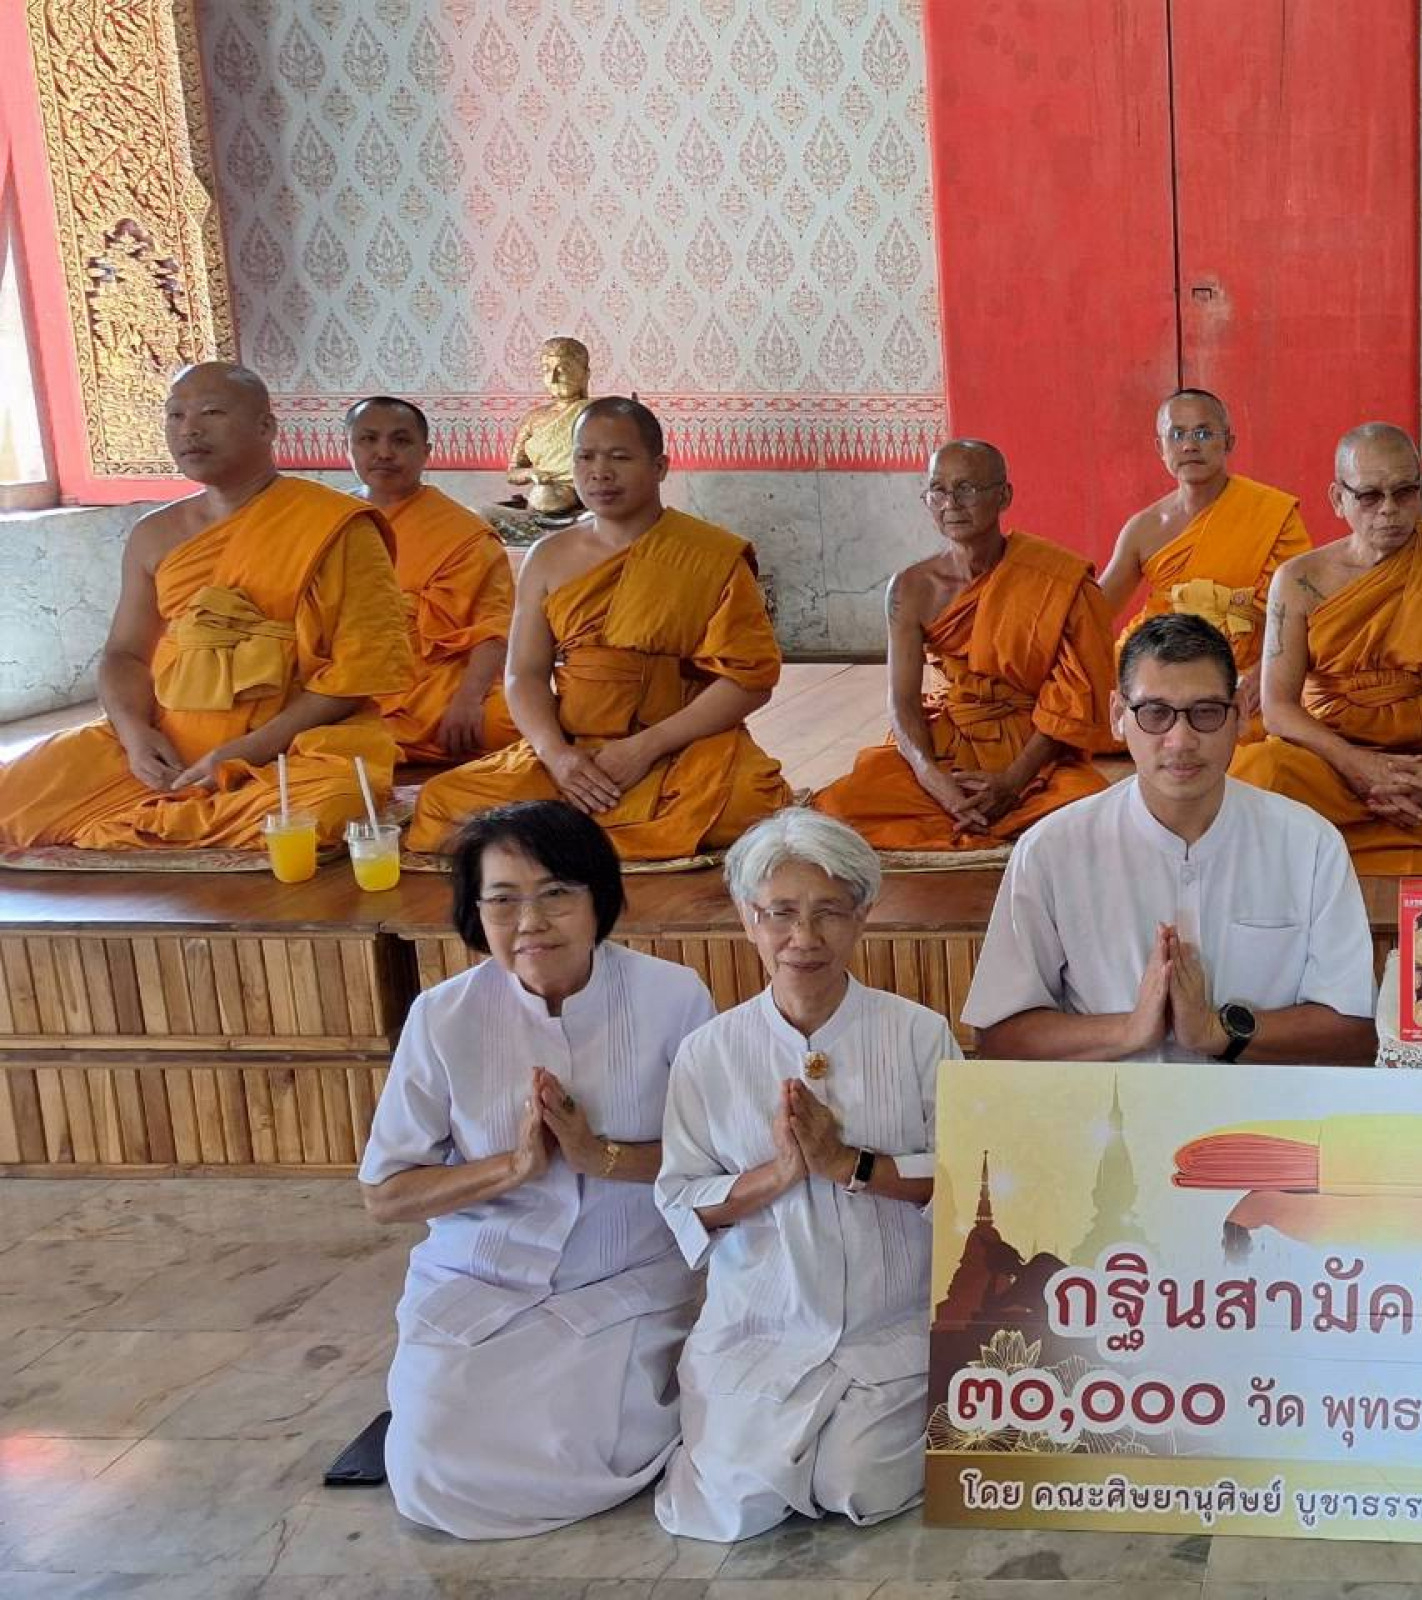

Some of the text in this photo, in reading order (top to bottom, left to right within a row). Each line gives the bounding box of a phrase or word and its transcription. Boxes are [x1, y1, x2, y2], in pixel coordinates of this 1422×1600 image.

[957, 1377, 1227, 1433] ๓๐,๐๐๐
[1247, 1376, 1305, 1428] วัด
[963, 1473, 1020, 1507] โดย
[1035, 1479, 1282, 1523] คณะศิษยานุศิษย์
